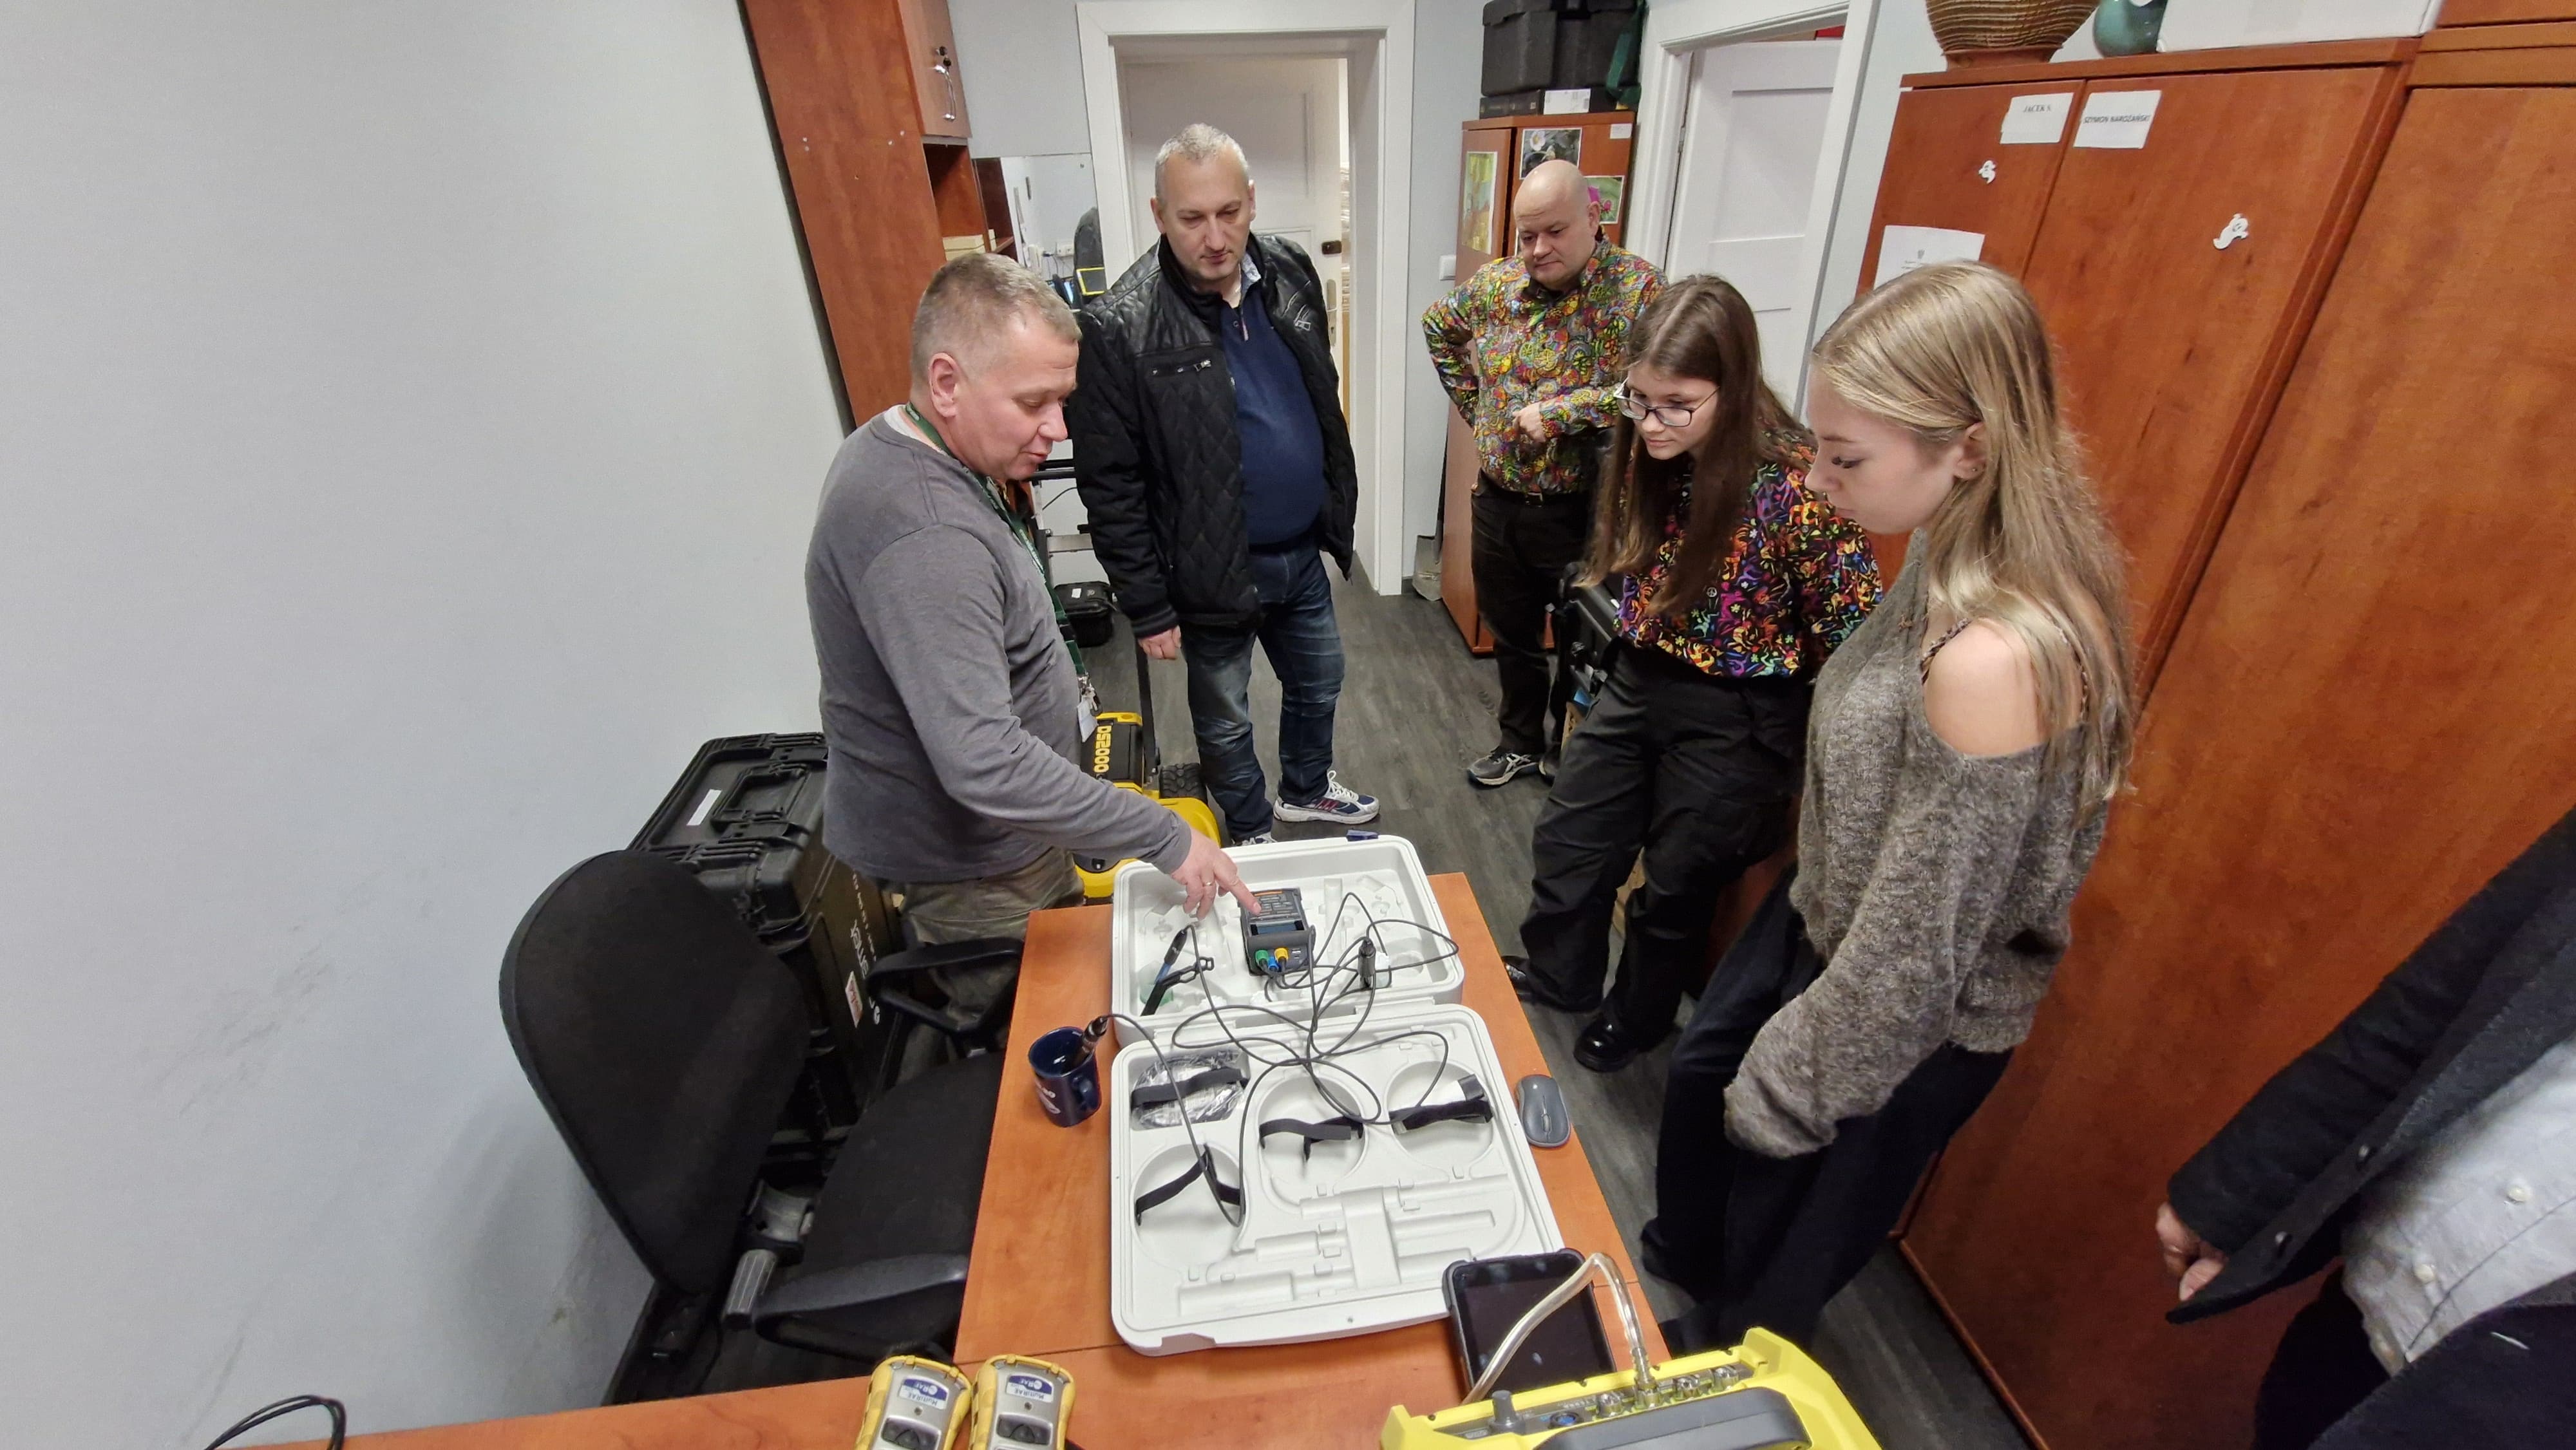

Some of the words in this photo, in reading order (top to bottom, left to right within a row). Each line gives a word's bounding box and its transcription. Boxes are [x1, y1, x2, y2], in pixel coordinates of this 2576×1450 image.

[1094, 724, 1112, 773] DS2000
[908, 1393, 938, 1406] MultiRAE
[1014, 1389, 1045, 1400] MultiRAE
